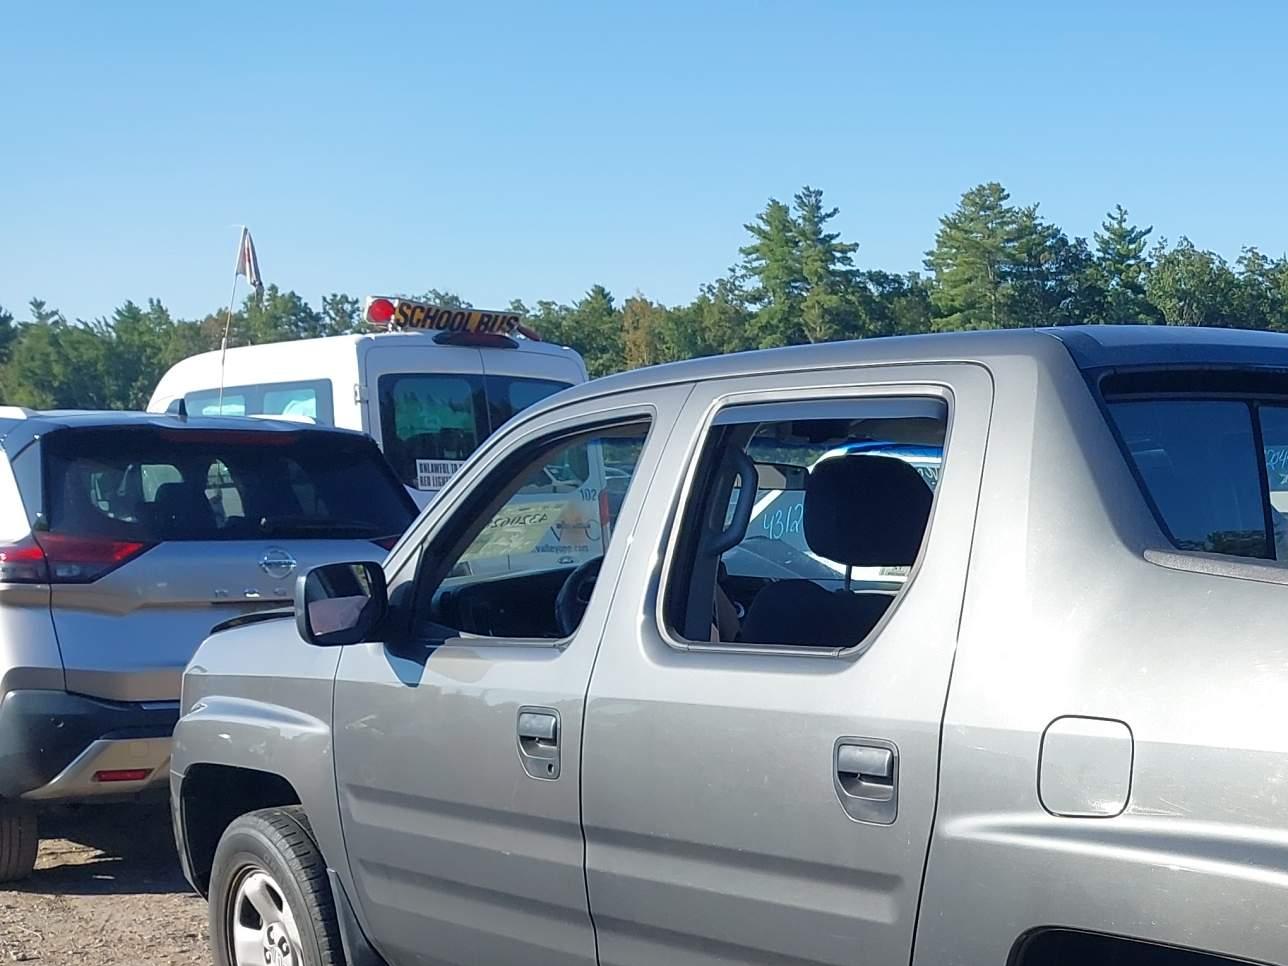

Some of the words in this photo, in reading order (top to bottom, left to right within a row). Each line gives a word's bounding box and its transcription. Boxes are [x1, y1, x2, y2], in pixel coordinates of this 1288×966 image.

[396, 301, 474, 332] SCHOOL
[476, 311, 520, 334] BUS
[580, 488, 597, 501] 102
